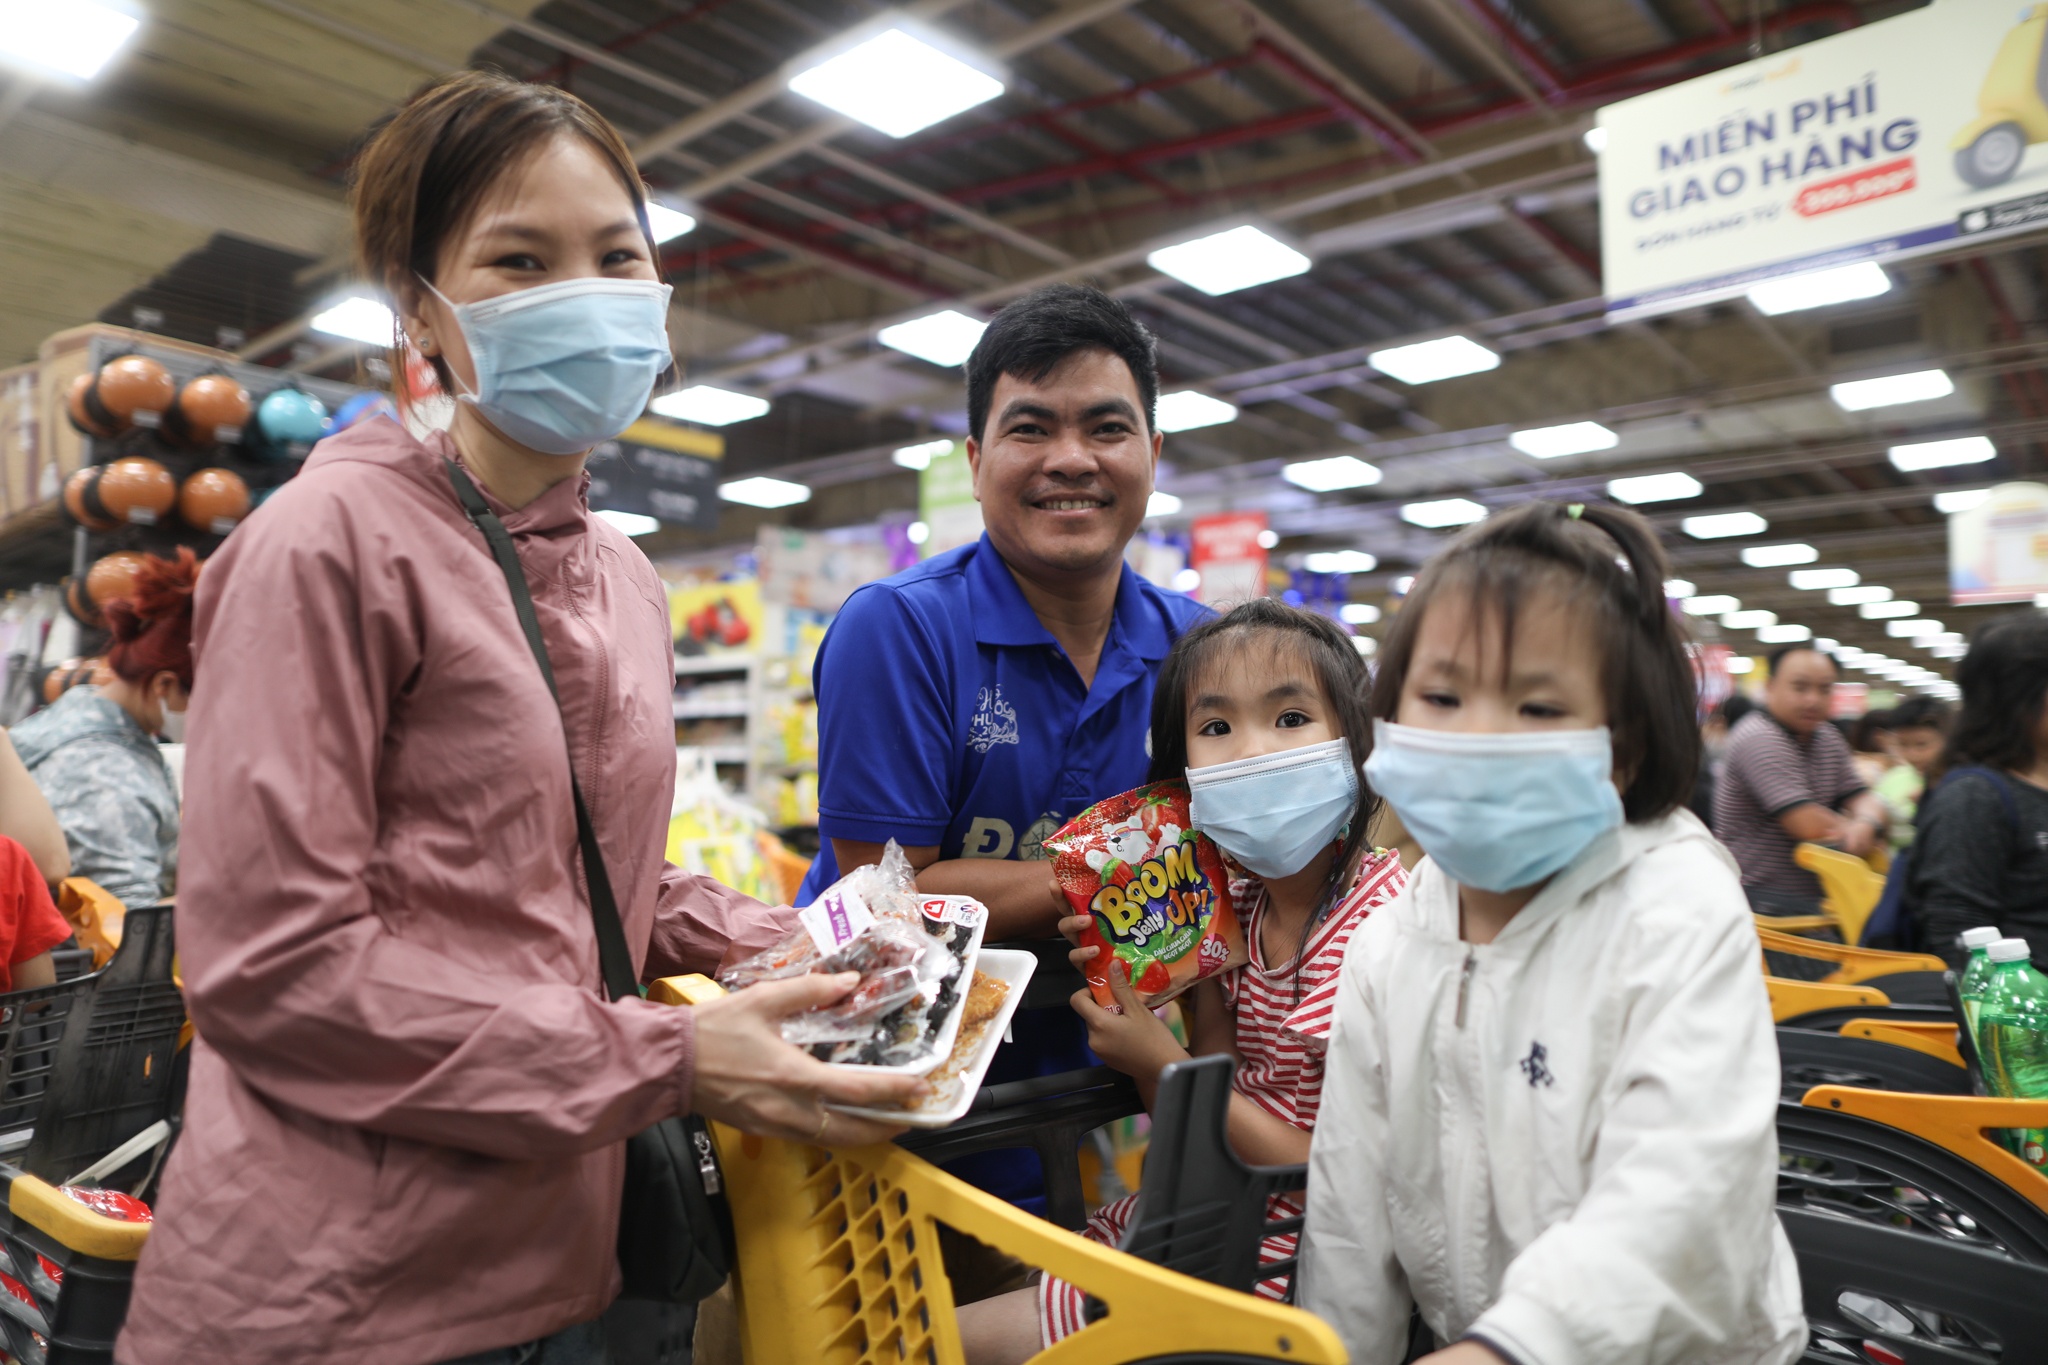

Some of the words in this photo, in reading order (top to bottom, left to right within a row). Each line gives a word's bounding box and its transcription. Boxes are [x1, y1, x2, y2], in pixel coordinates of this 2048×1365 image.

[1630, 166, 1746, 219] GIAO
[1762, 117, 1919, 186] HÀNG
[1659, 109, 1776, 170] MIỄN
[1792, 71, 1877, 134] PHÍ
[1091, 840, 1203, 937] BOOM
[1129, 910, 1165, 946] Jelly
[1200, 938, 1230, 962] 30%
